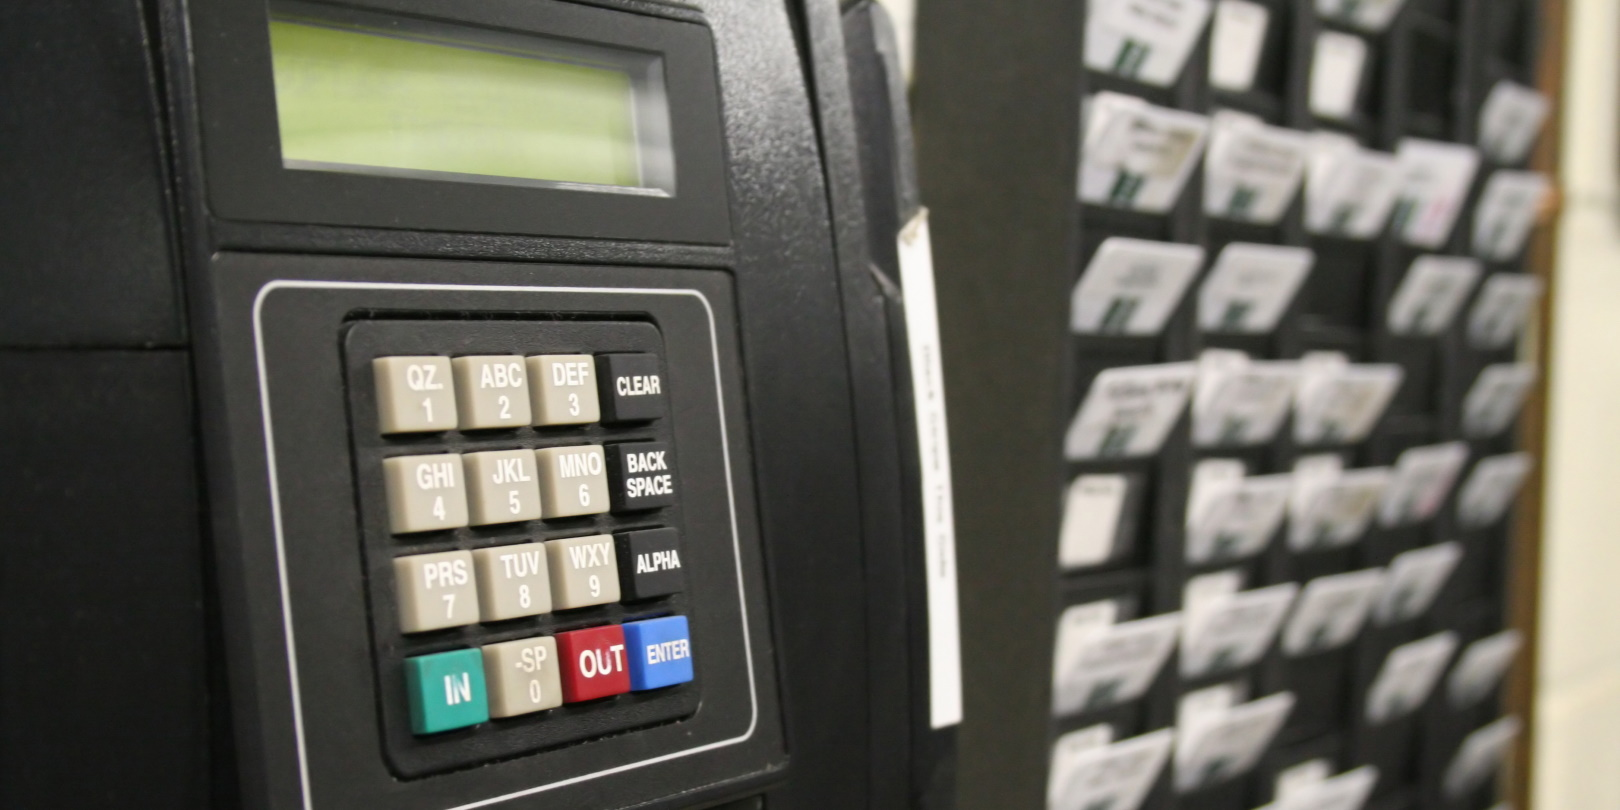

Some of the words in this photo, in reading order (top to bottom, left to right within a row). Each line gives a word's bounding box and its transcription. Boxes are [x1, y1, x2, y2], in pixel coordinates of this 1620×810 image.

[481, 362, 523, 389] ABC
[552, 362, 589, 387] DEF
[616, 375, 661, 397] CLEAR
[421, 398, 433, 422] 1
[498, 396, 512, 420] 2
[568, 393, 580, 417] 3
[492, 459, 531, 484] JKL
[559, 452, 602, 479] MNO
[626, 451, 668, 474] BACK
[416, 463, 455, 490] GHI
[626, 474, 673, 498] SPACE
[509, 491, 521, 515] 5
[578, 484, 590, 507] 6
[432, 496, 446, 521] 4
[500, 551, 540, 579] TUV
[569, 542, 611, 570] WXY
[636, 549, 681, 575] ALPHA
[424, 559, 469, 589] PRS
[589, 575, 601, 598] 9
[442, 594, 456, 619] 7
[519, 584, 531, 609] 8
[579, 644, 624, 679] OUT
[647, 639, 690, 666] ENTER
[443, 672, 471, 706] IN
[529, 679, 542, 704] 0
